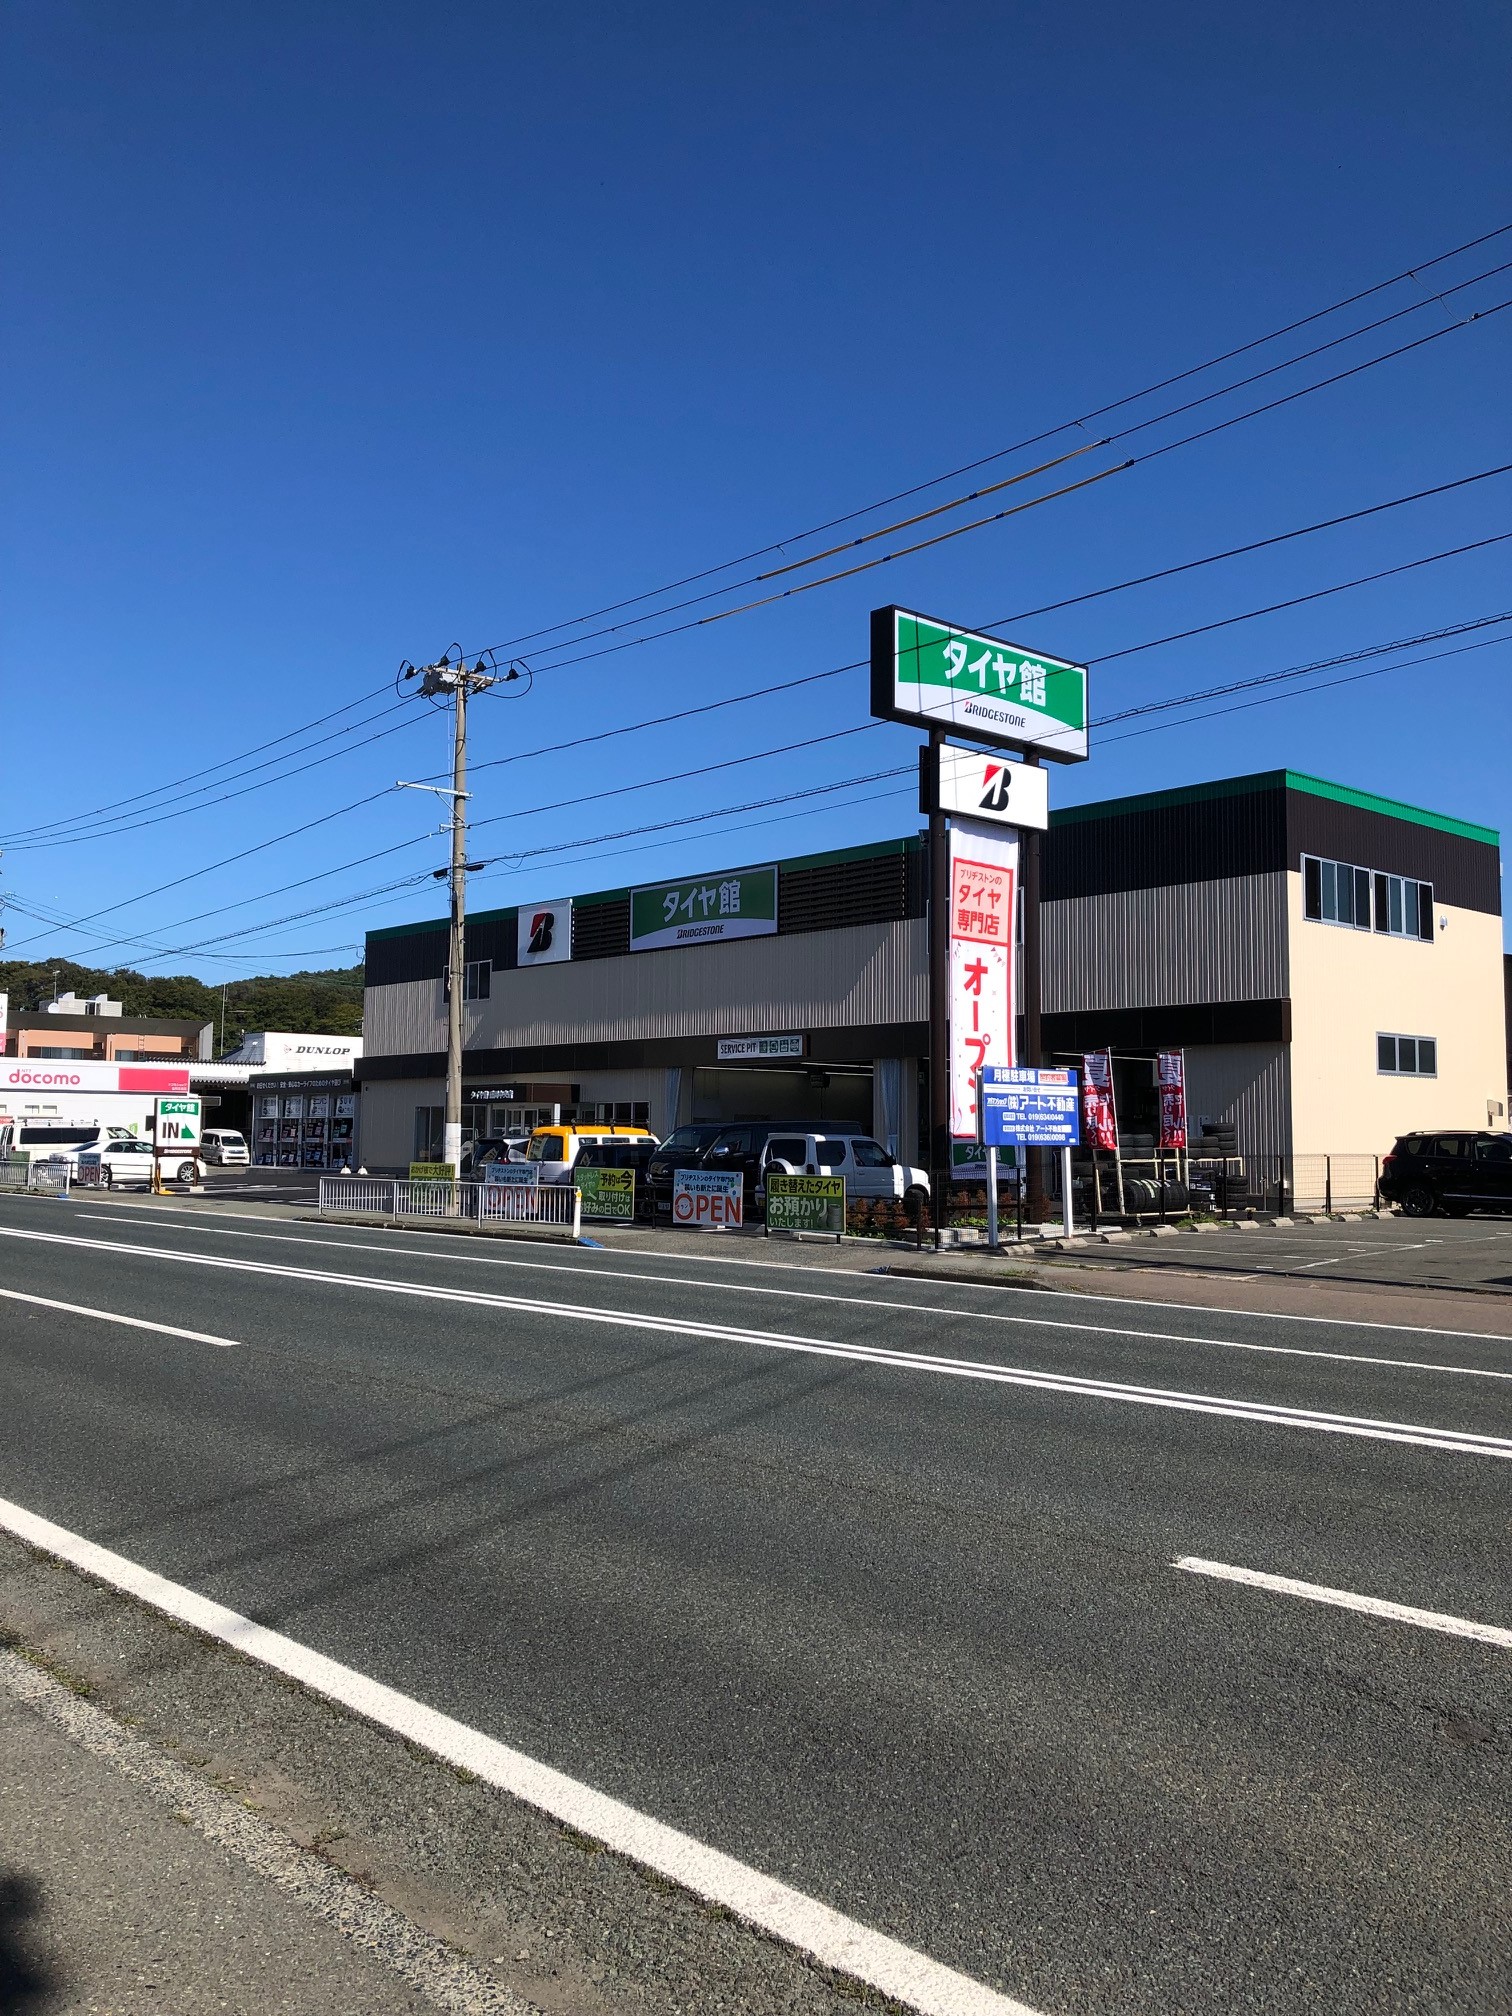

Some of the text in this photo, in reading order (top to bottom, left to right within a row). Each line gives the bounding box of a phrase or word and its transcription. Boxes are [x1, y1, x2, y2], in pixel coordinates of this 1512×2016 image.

[943, 640, 1047, 707] タイヤ館
[964, 701, 1026, 728] BRIDGESTONE
[960, 869, 1002, 885] ブリヂストンの
[662, 879, 741, 922] タイヤ館
[959, 885, 1002, 910] タイヤ
[958, 909, 1000, 935] 専門店
[676, 924, 724, 939] BRIDGESTONE
[295, 1045, 351, 1055] DUNLOP
[720, 1042, 757, 1054] SERVICE PIT
[9, 1068, 80, 1085] docomo
[993, 1069, 1036, 1083] 月極駐車場
[165, 1103, 195, 1112] タイヤ館
[162, 1122, 179, 1138] IN
[1016, 1133, 1027, 1141] TEL
[78, 1166, 101, 1182] OPEN
[600, 1170, 633, 1191] 予約は今
[770, 1178, 841, 1195] 履き替えたタイヤ
[598, 1190, 631, 1202] 取り付けは
[675, 1193, 741, 1223] OPEN
[769, 1196, 828, 1217] お預かり
[769, 1217, 814, 1228] いたします!
